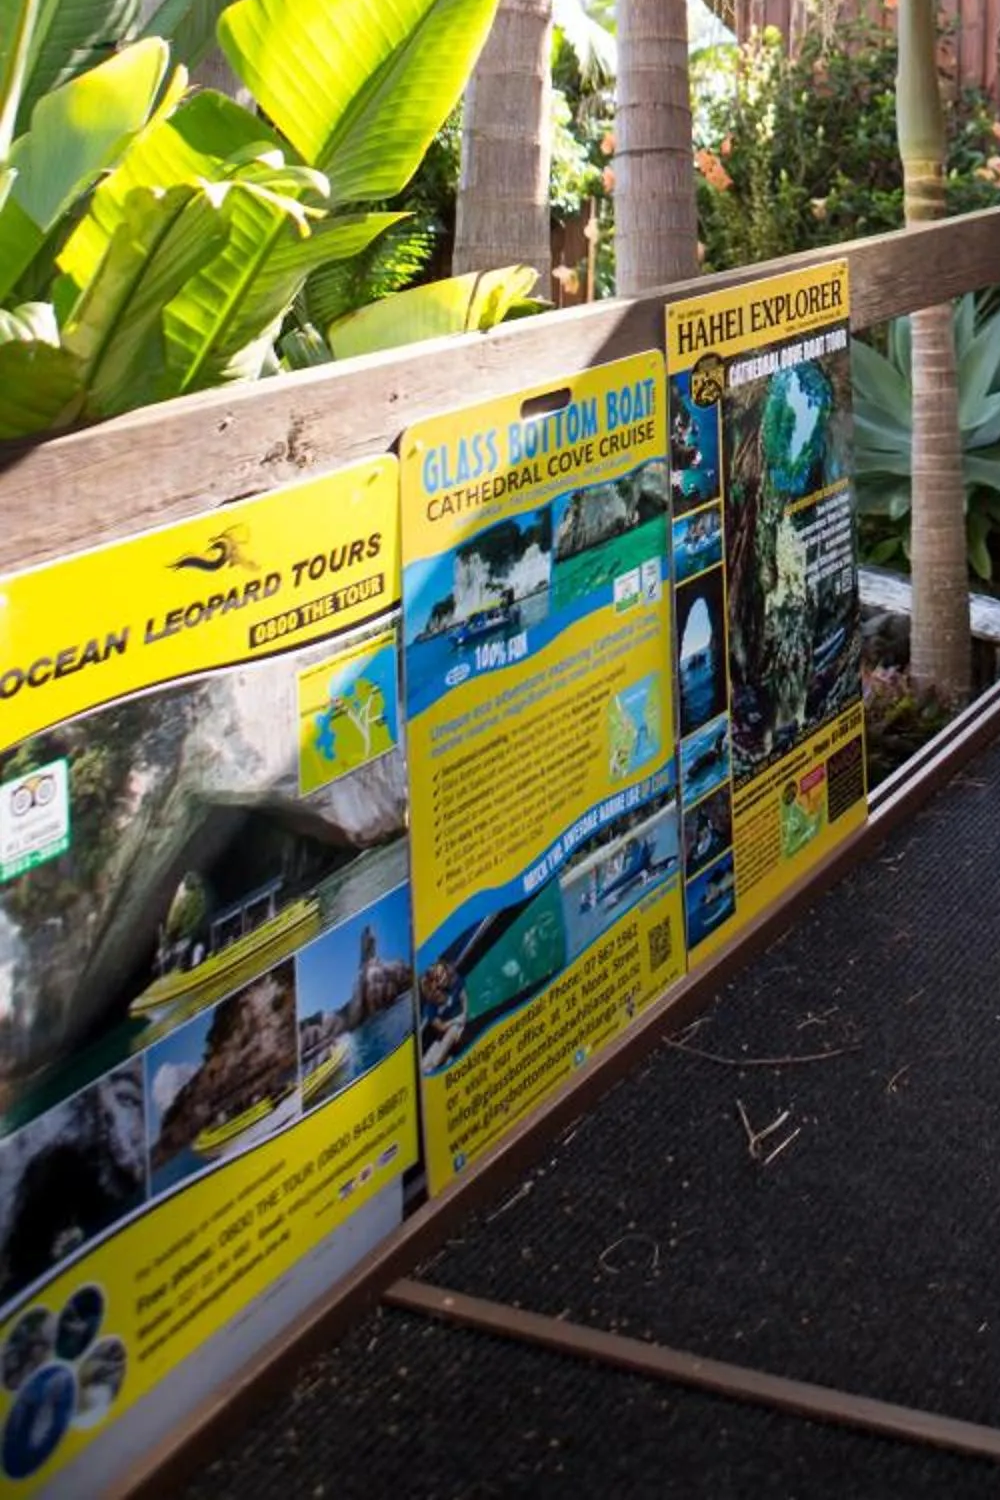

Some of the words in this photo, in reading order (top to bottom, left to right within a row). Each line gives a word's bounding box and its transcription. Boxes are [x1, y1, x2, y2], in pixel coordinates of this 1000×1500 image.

[677, 307, 744, 355] HAHEI
[750, 279, 842, 332] EXPLORER
[730, 351, 779, 387] CATHEDRAL
[803, 335, 825, 361] BOAT
[825, 328, 847, 353] TOUR
[424, 429, 497, 494] GLASS
[508, 397, 598, 465] BOTTOM
[606, 379, 654, 430] BOAT
[426, 464, 542, 522] CATHEDRAL
[547, 445, 593, 476] COVE
[599, 421, 655, 457] CRUISE
[0, 626, 130, 700] OCEAN
[143, 573, 282, 645] LEOPARD
[291, 533, 383, 587] TOURS
[253, 610, 298, 647] 0800
[301, 596, 335, 626] THE
[338, 576, 383, 609] TOUR
[474, 639, 506, 671] 100%
[507, 631, 528, 661] FUN
[446, 1040, 496, 1089] Bookings
[583, 956, 597, 975] 07
[447, 1092, 459, 1110] or
[493, 1052, 511, 1071] our
[516, 1024, 546, 1052] office
[256, 1189, 280, 1215] THE
[282, 1160, 315, 1195] TOUR
